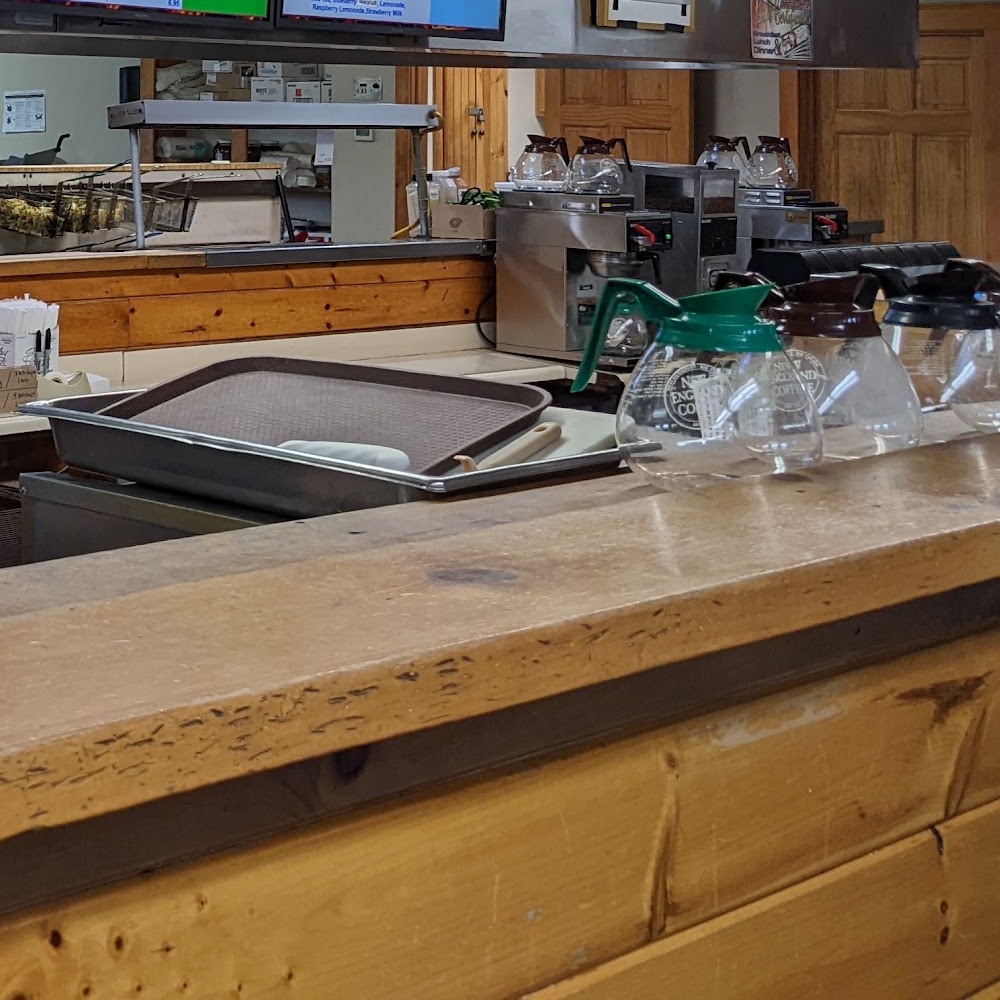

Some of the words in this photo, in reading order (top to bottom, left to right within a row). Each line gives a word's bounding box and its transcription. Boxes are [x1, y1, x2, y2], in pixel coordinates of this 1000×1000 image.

[312, 3, 338, 13] Raspberry
[753, 38, 771, 46] Lunch
[753, 46, 776, 54] Dinner
